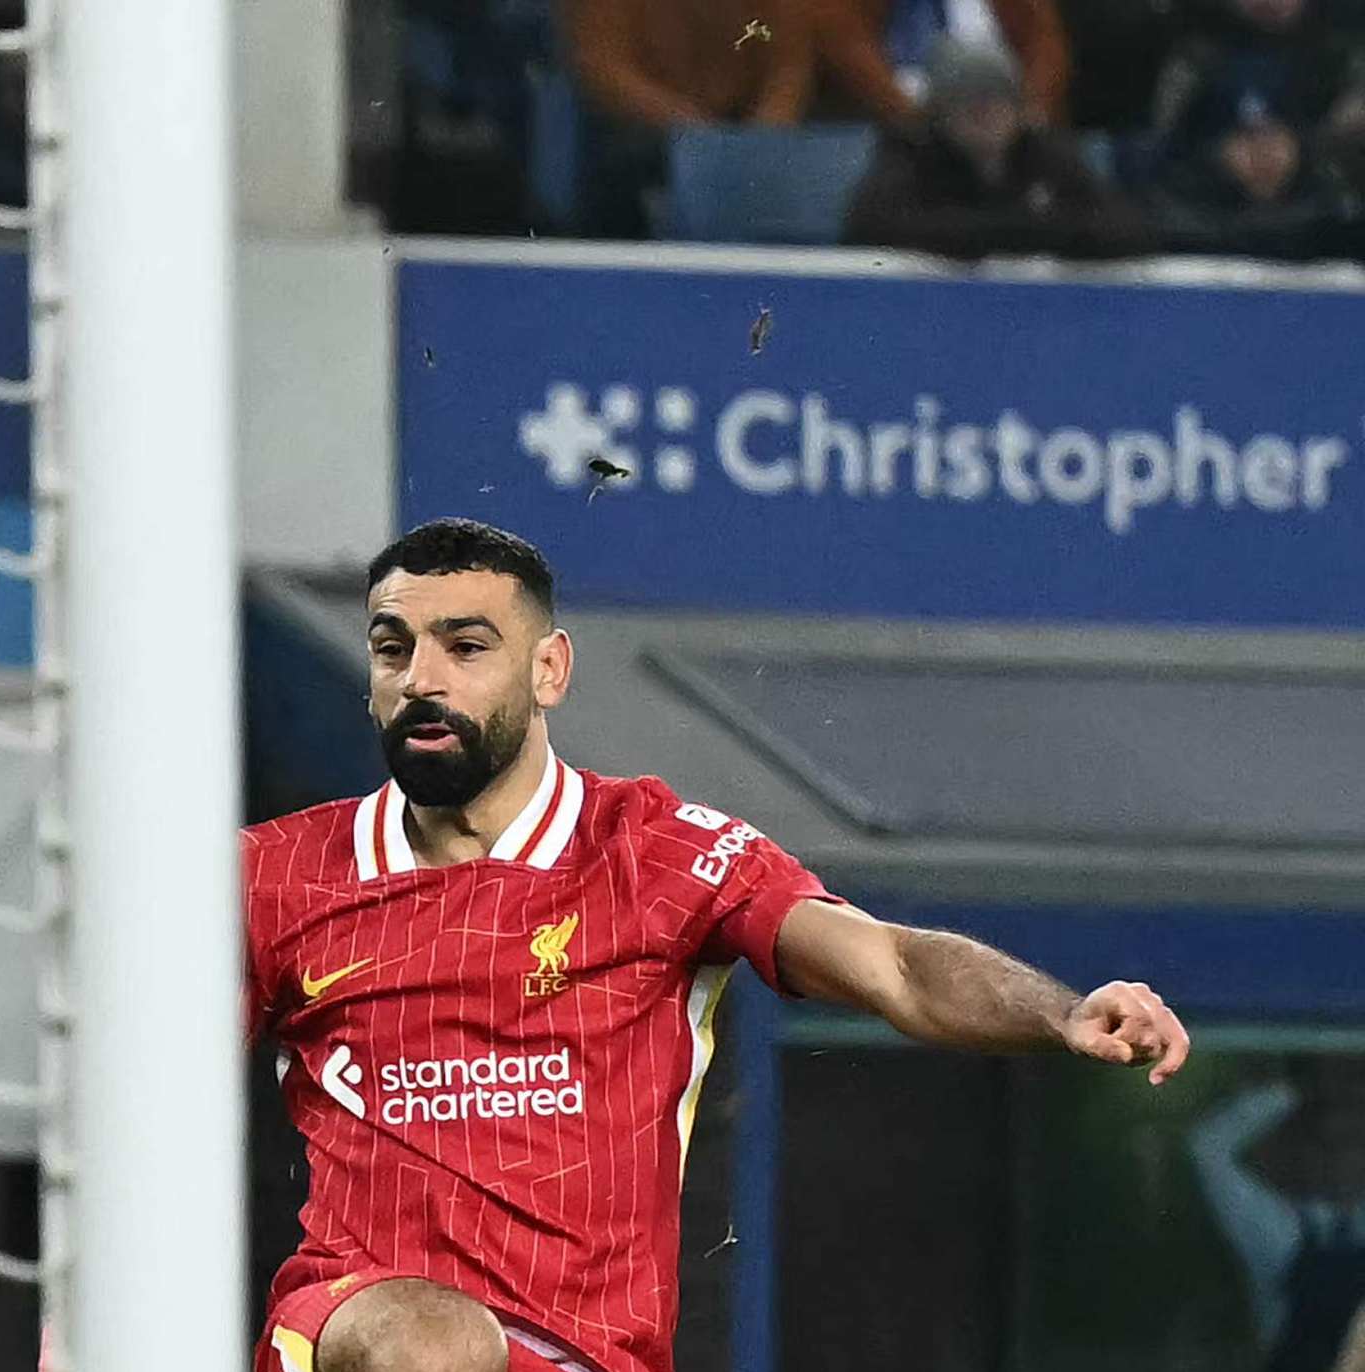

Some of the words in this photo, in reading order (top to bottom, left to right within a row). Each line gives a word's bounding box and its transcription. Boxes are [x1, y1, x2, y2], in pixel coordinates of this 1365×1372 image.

[714, 388, 1346, 533] Christopher
[380, 1047, 569, 1092] standard
[382, 1080, 584, 1125] chartered
